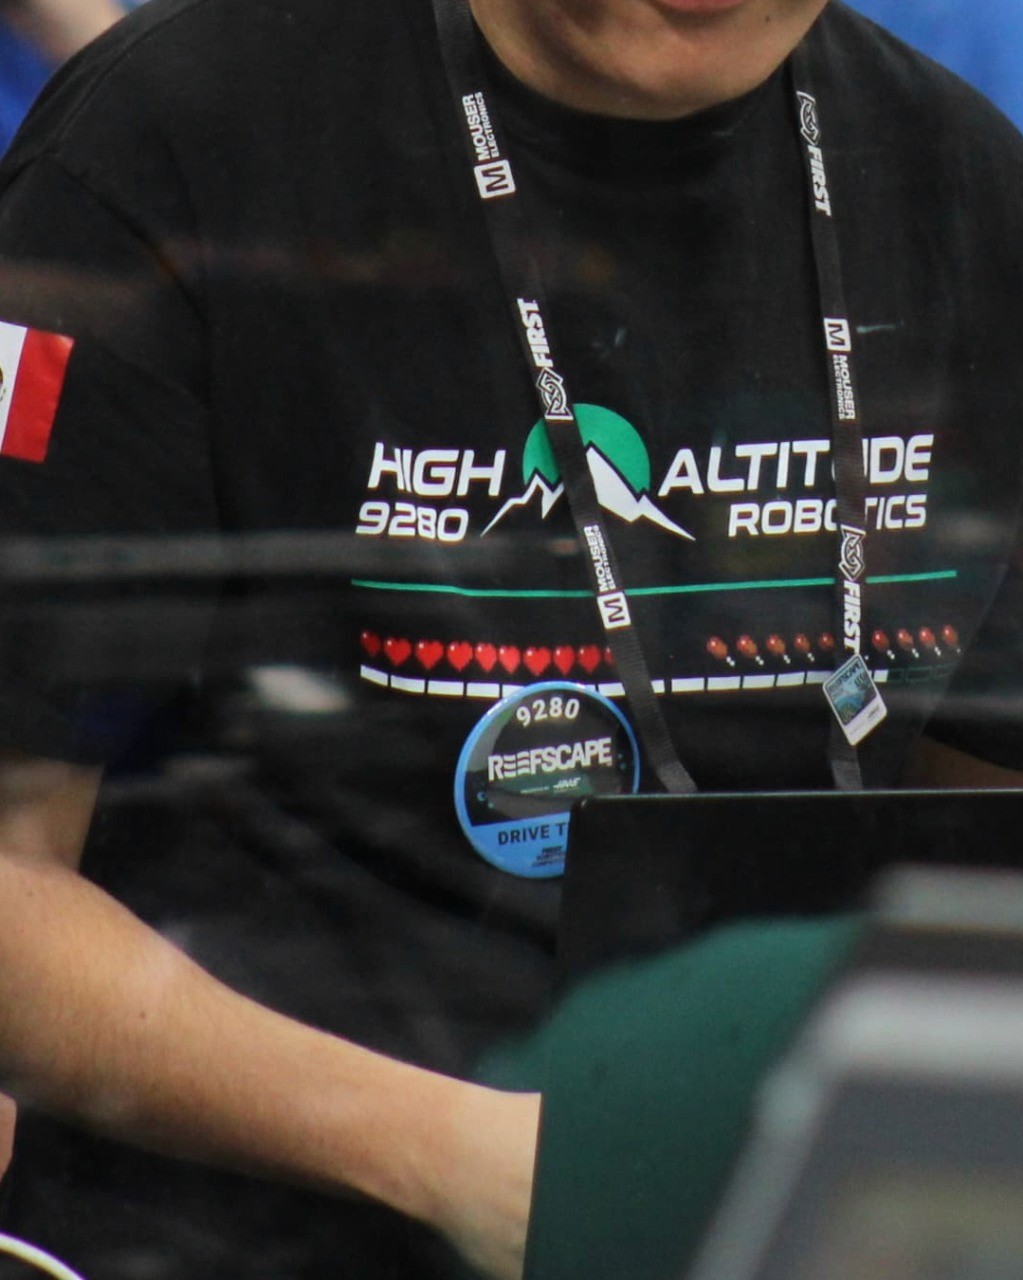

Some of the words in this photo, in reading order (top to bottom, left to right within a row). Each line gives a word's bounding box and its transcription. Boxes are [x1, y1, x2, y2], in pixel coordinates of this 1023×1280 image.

[462, 94, 490, 161] MOUSER
[474, 91, 500, 158] ELECTRONICS
[480, 165, 510, 194] M
[807, 145, 832, 217] FIRST
[517, 298, 554, 368] FIRST
[826, 322, 847, 347] M
[839, 355, 856, 420] MOUSER
[367, 442, 506, 497] HIGH
[657, 433, 935, 497] ALTITDE
[355, 501, 469, 542] 9280
[584, 525, 610, 592] MOUSER
[602, 596, 627, 624] M
[843, 580, 861, 655] FIRST
[516, 697, 580, 727] 9280
[487, 737, 613, 782] REEFSCAPE
[498, 825, 550, 846] DRIVE
